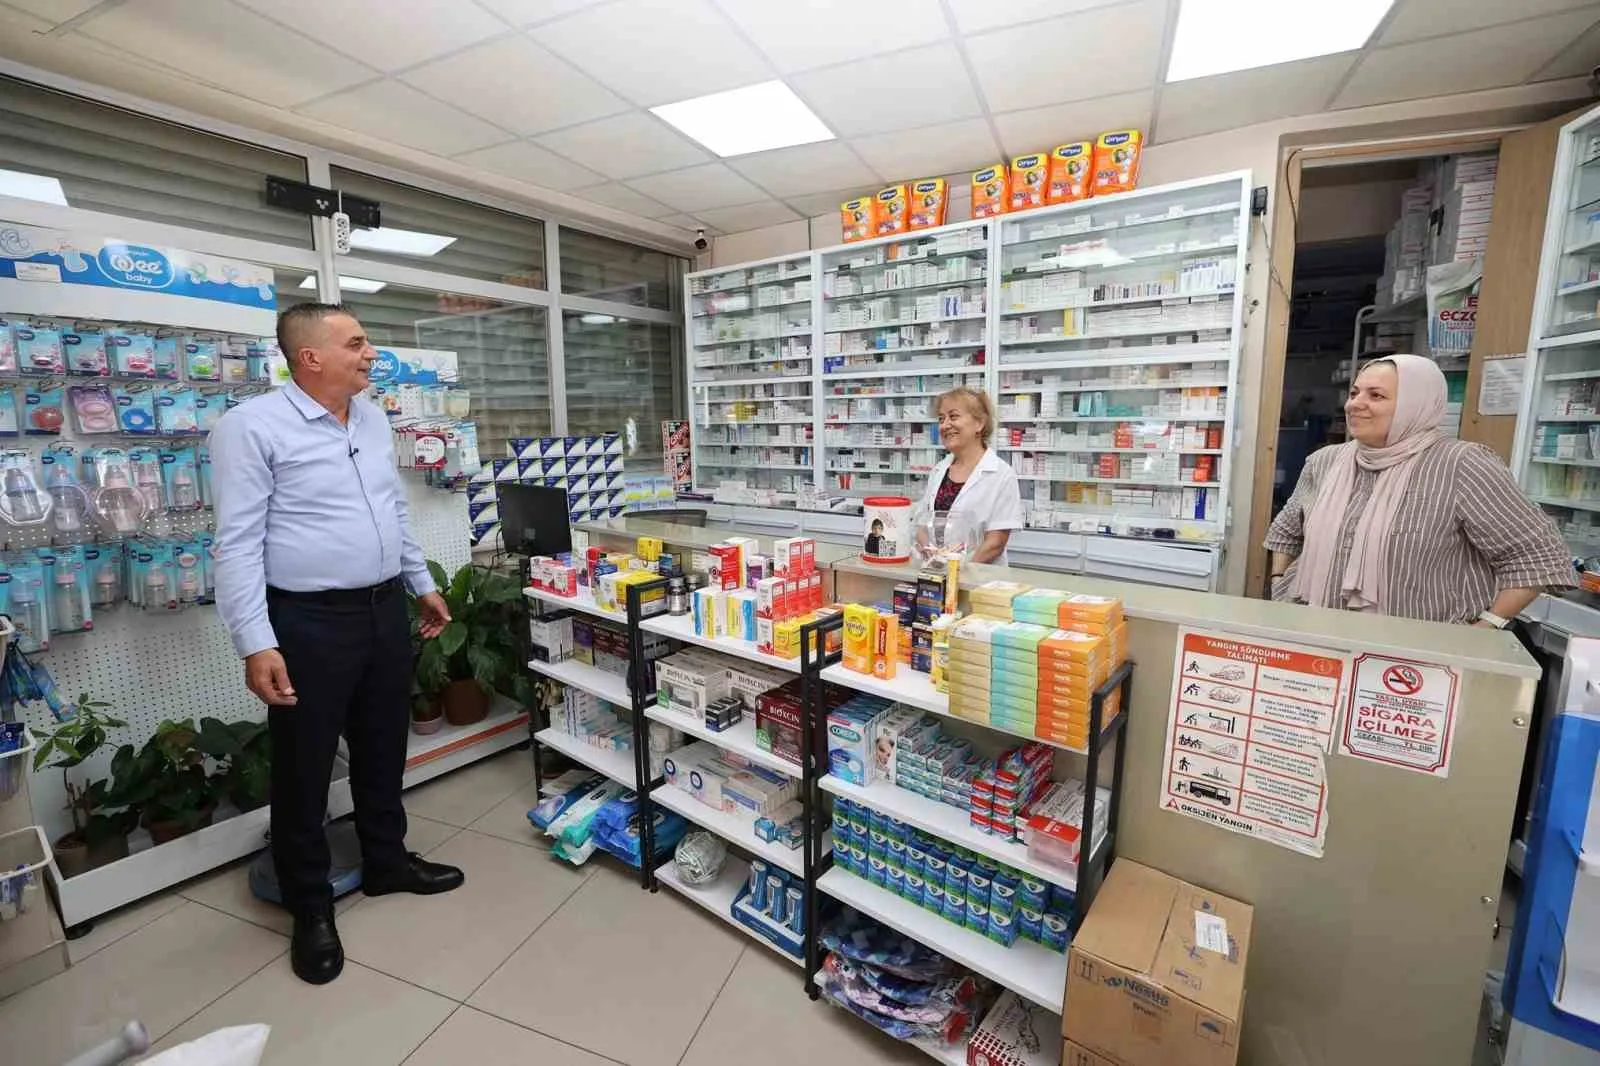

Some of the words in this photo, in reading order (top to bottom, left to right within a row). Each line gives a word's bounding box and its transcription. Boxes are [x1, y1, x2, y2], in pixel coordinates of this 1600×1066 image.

[125, 272, 152, 285] baby
[1357, 716, 1437, 741] İÇİLMEZ
[1359, 705, 1435, 729] SİGARA
